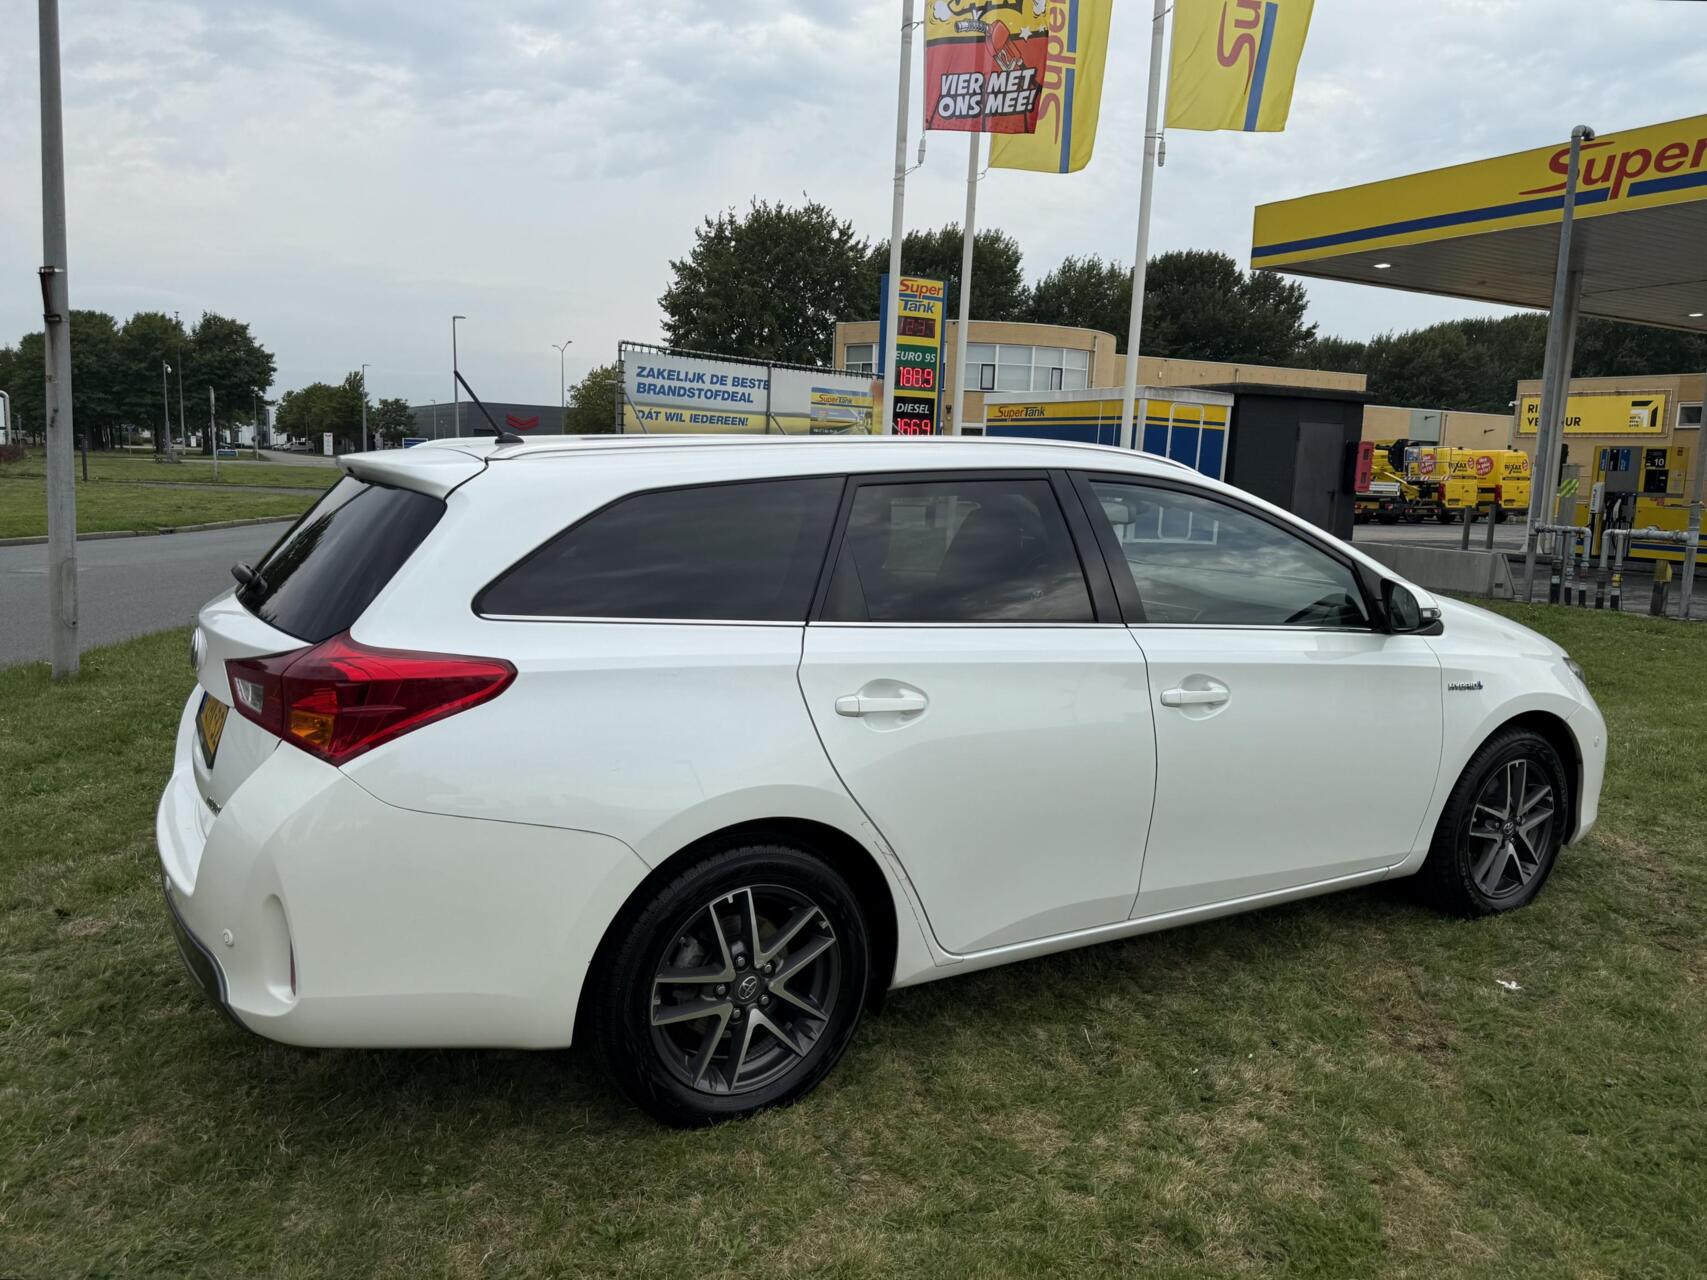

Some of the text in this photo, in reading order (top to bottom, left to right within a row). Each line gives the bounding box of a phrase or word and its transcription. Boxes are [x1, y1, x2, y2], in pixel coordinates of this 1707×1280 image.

[941, 68, 1036, 96] VIER MET
[1037, 0, 1077, 145] Supe
[938, 90, 1037, 117] ONS MEE!
[1518, 137, 1707, 200] Super
[898, 278, 943, 299] Super
[899, 298, 934, 313] Tank
[896, 351, 936, 363] EURO 95
[636, 366, 769, 391] ZAKELIJK DE BESTE
[899, 366, 933, 388] 188.9
[636, 382, 754, 403] BRANDSTOFDEAL
[896, 403, 930, 414] DIESEL
[996, 406, 1045, 420] SuperTank
[664, 412, 686, 423] WIL
[689, 413, 749, 427] IEDEREEN!
[1654, 458, 1665, 466] 10
